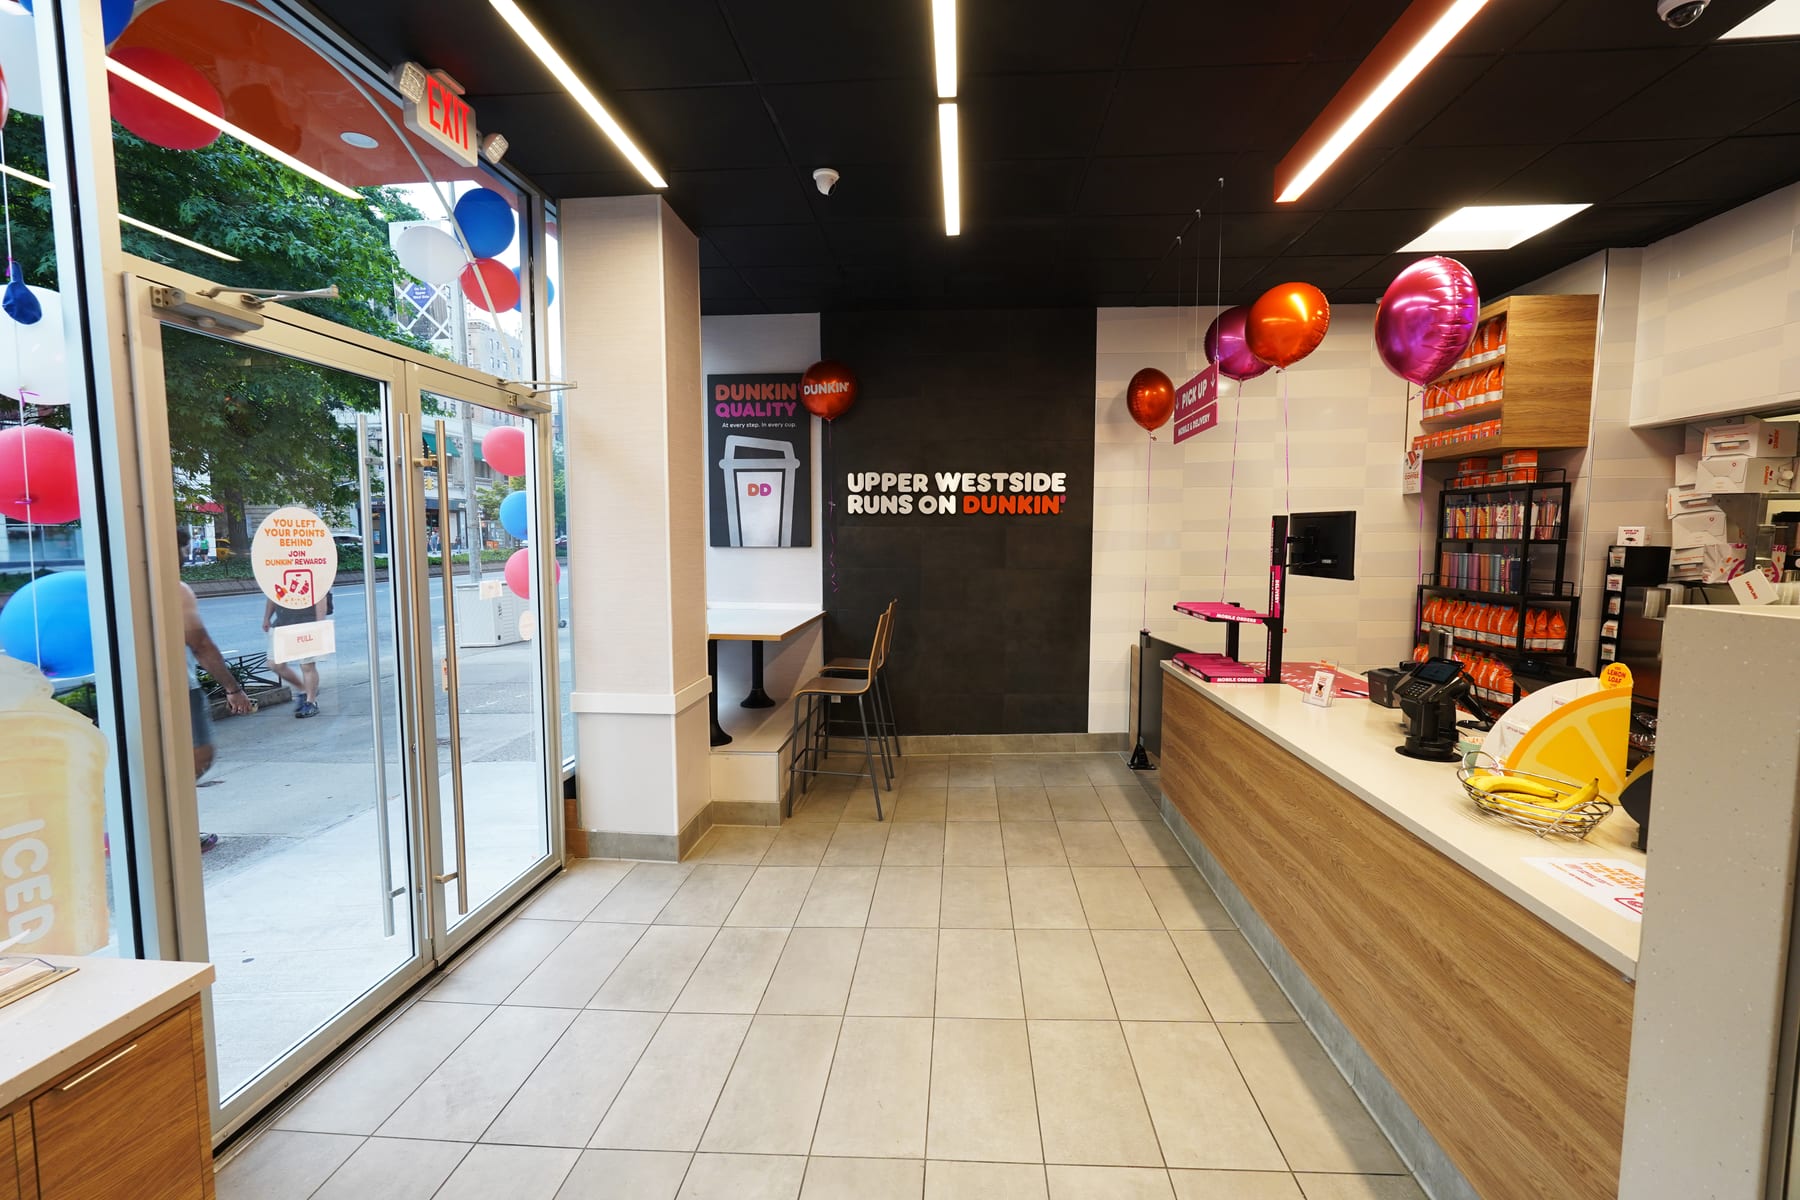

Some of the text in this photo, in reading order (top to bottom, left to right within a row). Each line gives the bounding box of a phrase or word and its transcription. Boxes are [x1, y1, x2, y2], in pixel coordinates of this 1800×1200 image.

[426, 74, 470, 150] EXIT
[803, 381, 849, 395] DUNKIN'
[1182, 379, 1208, 409] PICK UP
[715, 402, 797, 418] QUALITY
[847, 472, 1067, 493] UPPER WESTSIDE
[747, 483, 772, 496] DD
[847, 494, 1066, 515] RUNS ON DUNKIN'
[273, 519, 316, 528] YOU LEFT
[264, 529, 325, 537] YOUR POINTS
[280, 538, 313, 547] BEHIND
[288, 550, 306, 558] JOIN
[1216, 613, 1235, 621] MOBILE
[297, 634, 313, 643] PULL
[1607, 669, 1626, 678] LEMON
[1608, 676, 1622, 684] LOAF
[0, 819, 55, 944] ICED
